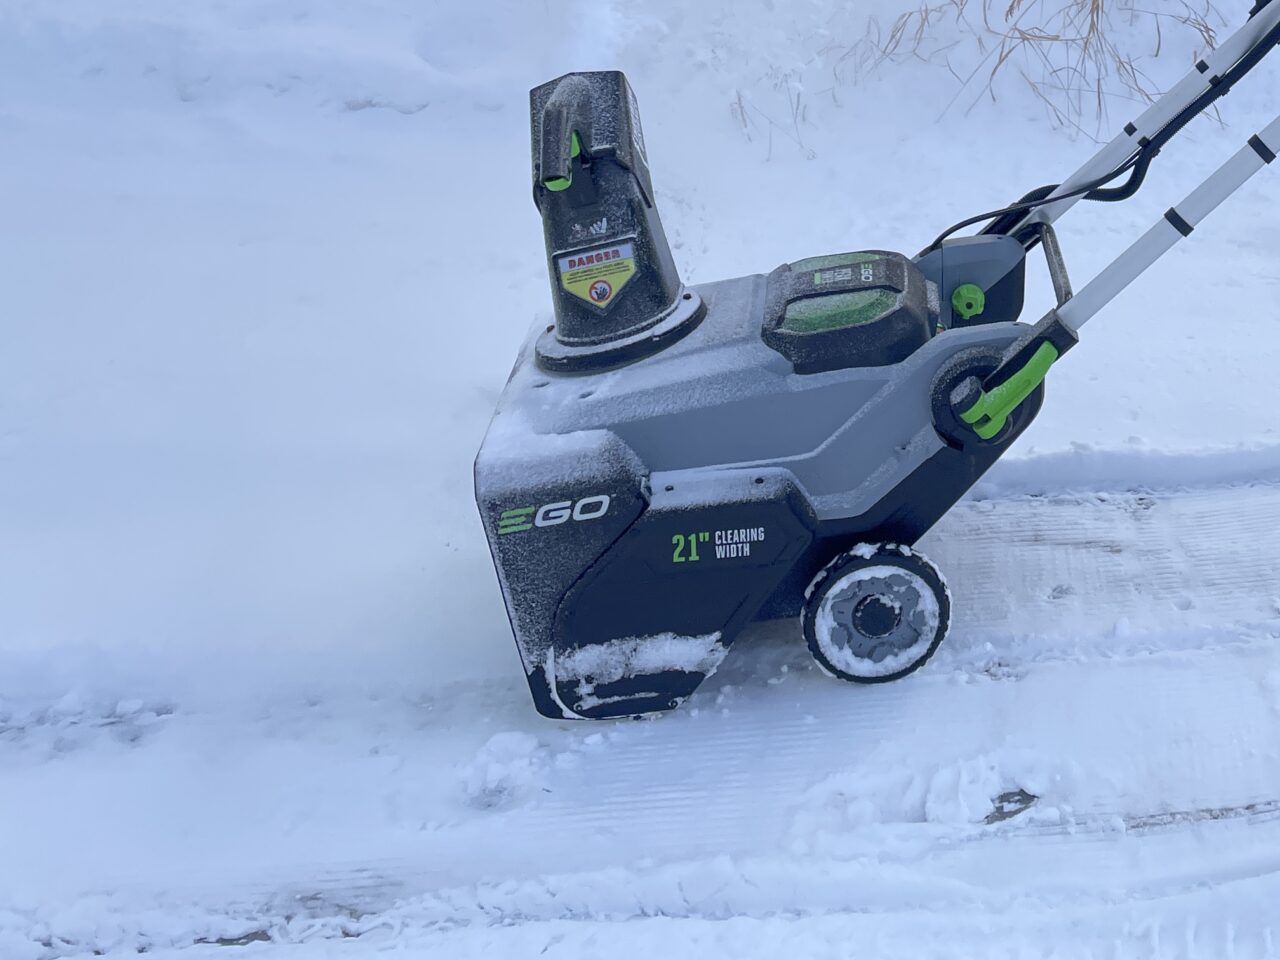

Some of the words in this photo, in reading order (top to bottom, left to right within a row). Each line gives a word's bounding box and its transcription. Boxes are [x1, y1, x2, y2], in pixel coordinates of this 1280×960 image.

[568, 249, 621, 270] DANGER
[498, 495, 610, 535] EGO
[672, 532, 710, 563] 21"
[715, 527, 765, 545] CLEARING
[715, 543, 750, 559] WIDTH
